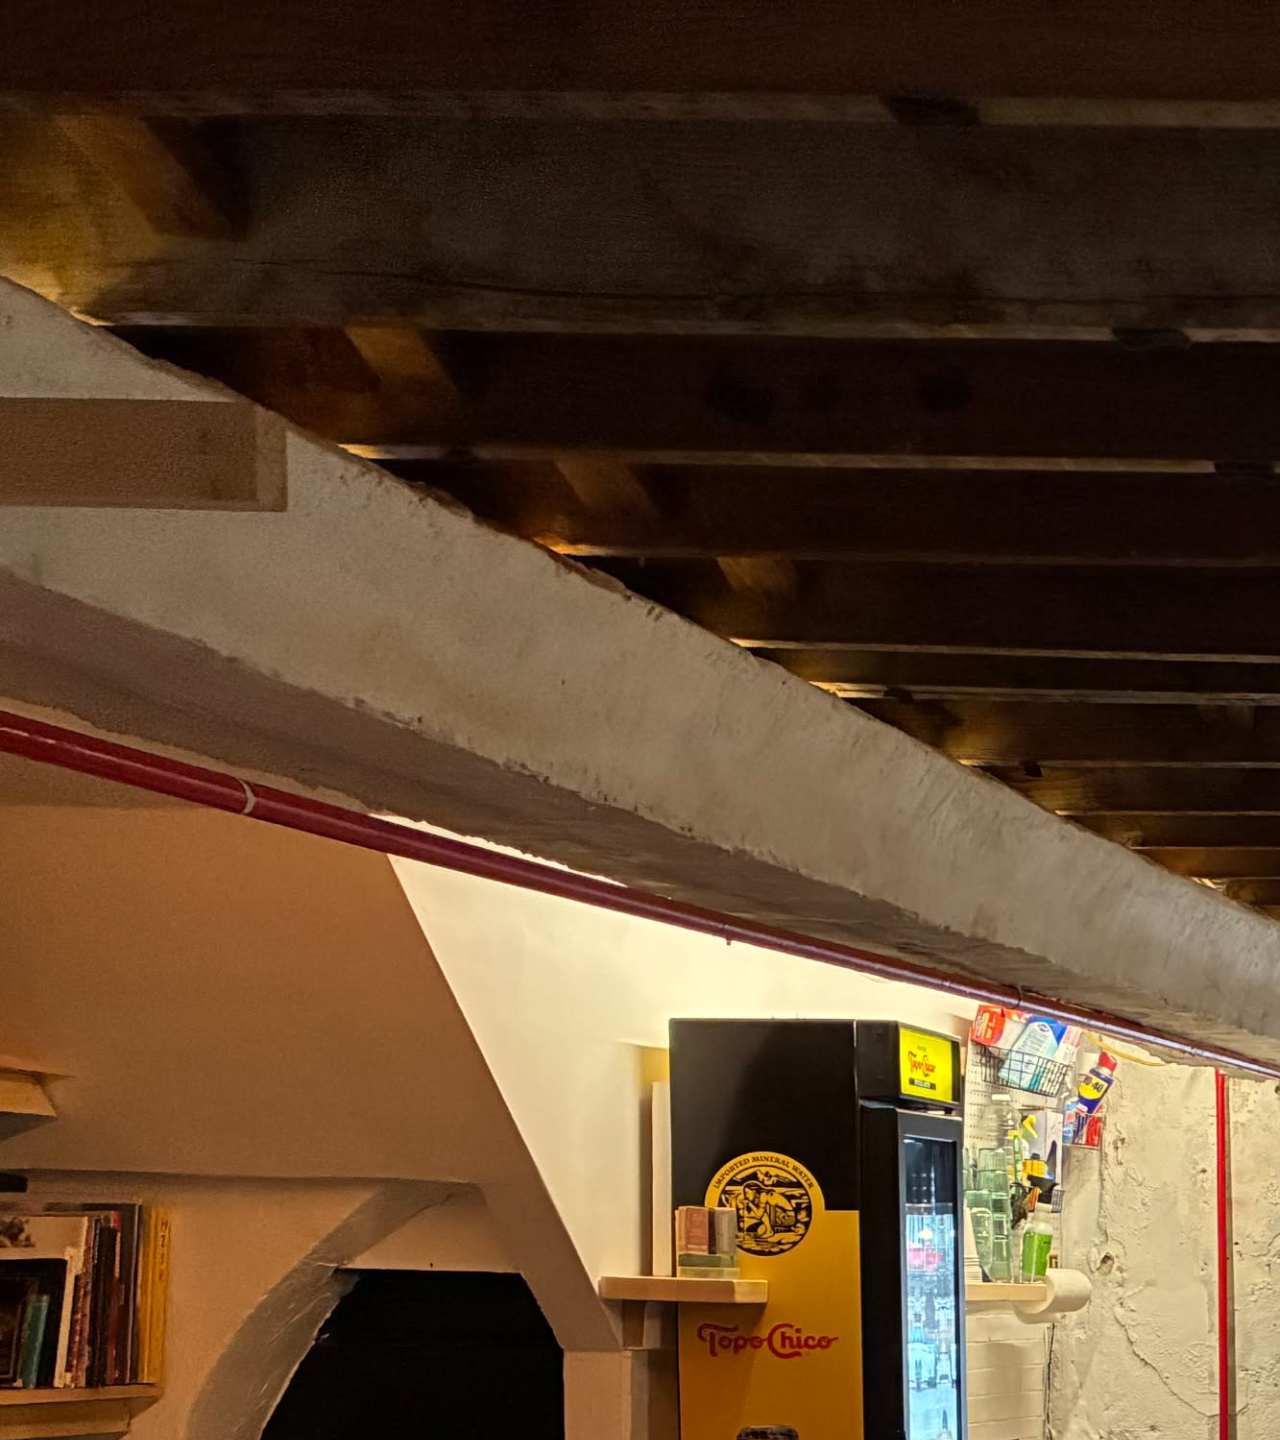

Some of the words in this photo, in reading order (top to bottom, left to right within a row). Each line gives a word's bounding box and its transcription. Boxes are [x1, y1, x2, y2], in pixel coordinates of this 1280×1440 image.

[713, 1158, 750, 1189] IMPORTED
[751, 1155, 790, 1167] MINERAL
[791, 1163, 814, 1189] WATER
